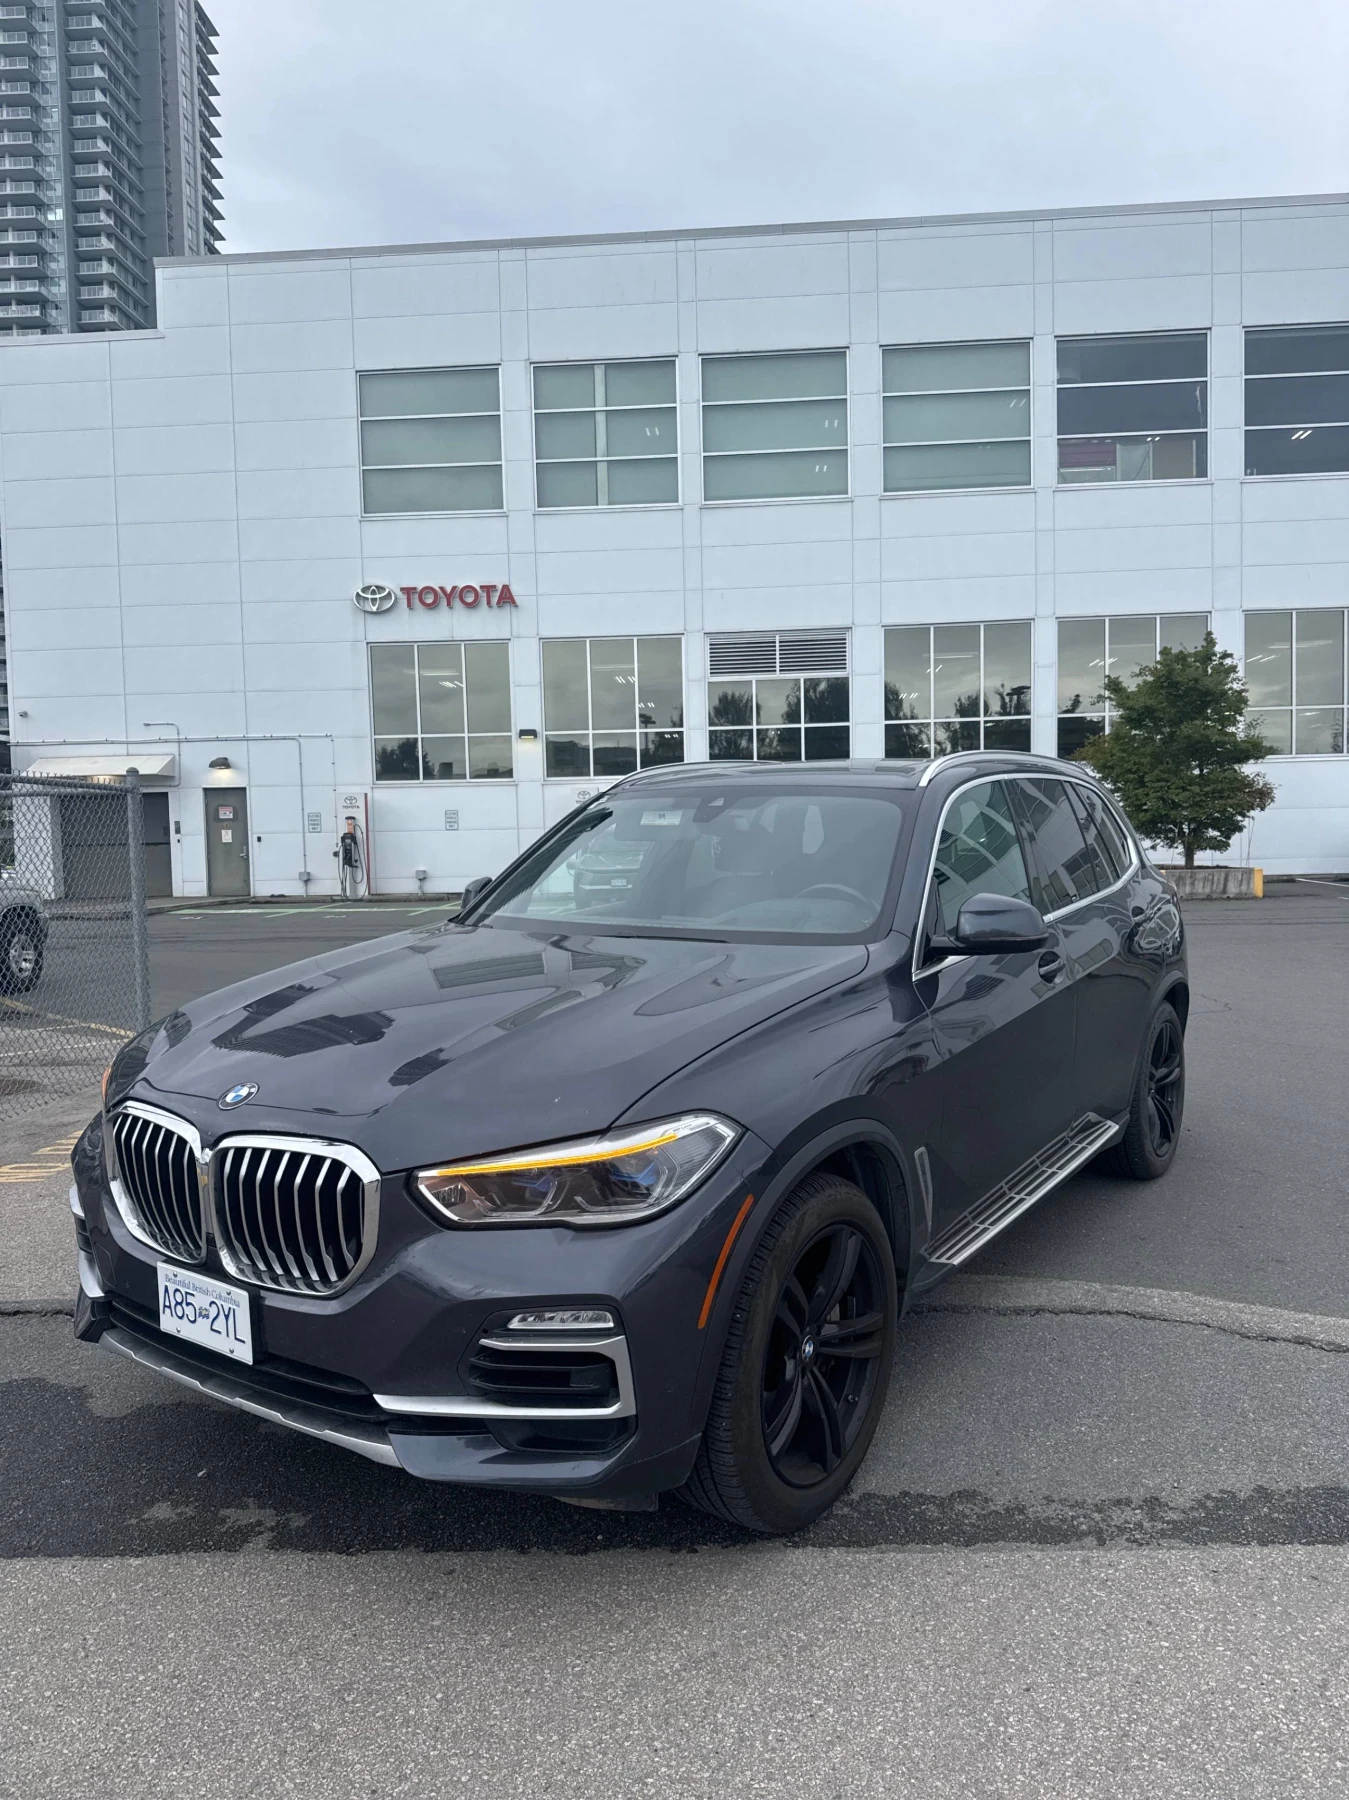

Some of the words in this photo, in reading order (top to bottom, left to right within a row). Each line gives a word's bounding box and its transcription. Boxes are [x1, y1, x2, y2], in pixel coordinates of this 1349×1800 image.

[400, 584, 518, 609] TOYOTA
[165, 1274, 191, 1291] Beautiful
[192, 1282, 211, 1296] British
[211, 1289, 240, 1308] Columbia
